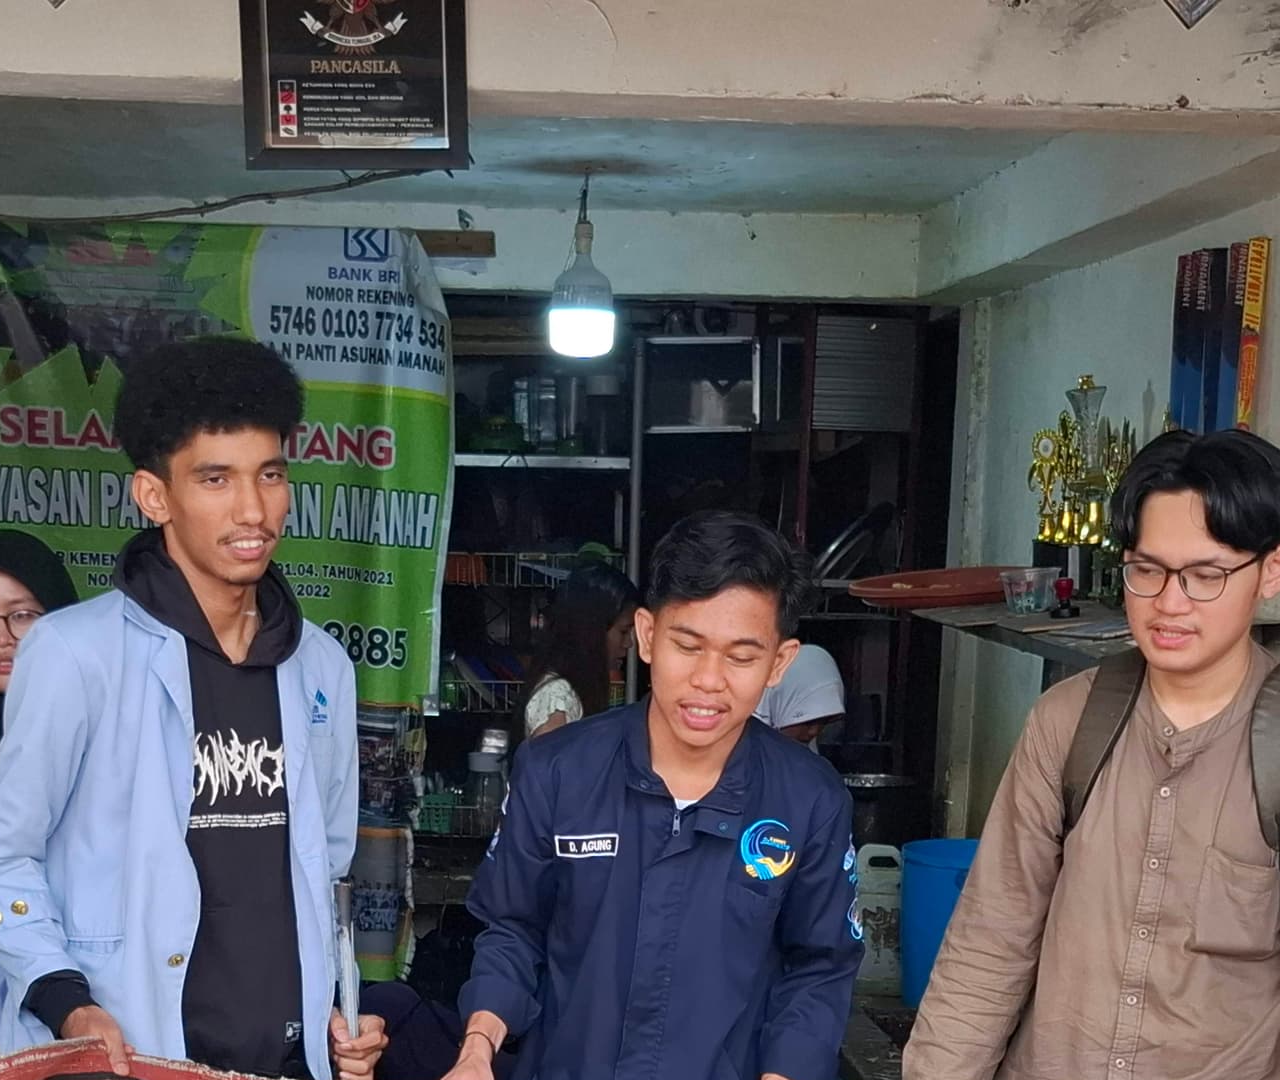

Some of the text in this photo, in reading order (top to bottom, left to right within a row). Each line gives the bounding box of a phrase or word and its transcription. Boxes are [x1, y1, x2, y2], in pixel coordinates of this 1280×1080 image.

[310, 59, 402, 74] PANCASILA
[328, 267, 401, 284] BANK BRI
[306, 286, 415, 308] NOMOR REKENING
[270, 305, 446, 352] 5746 0103 7734 534
[296, 343, 337, 362] PANTI
[340, 348, 392, 366] ASUHAN
[397, 352, 446, 376] AMANAH
[0, 405, 397, 470] SELA TANG
[328, 482, 439, 549] AMANAH
[322, 564, 361, 580] TAHUN
[363, 569, 394, 586] 2021
[568, 839, 613, 853] D. AGUNG
